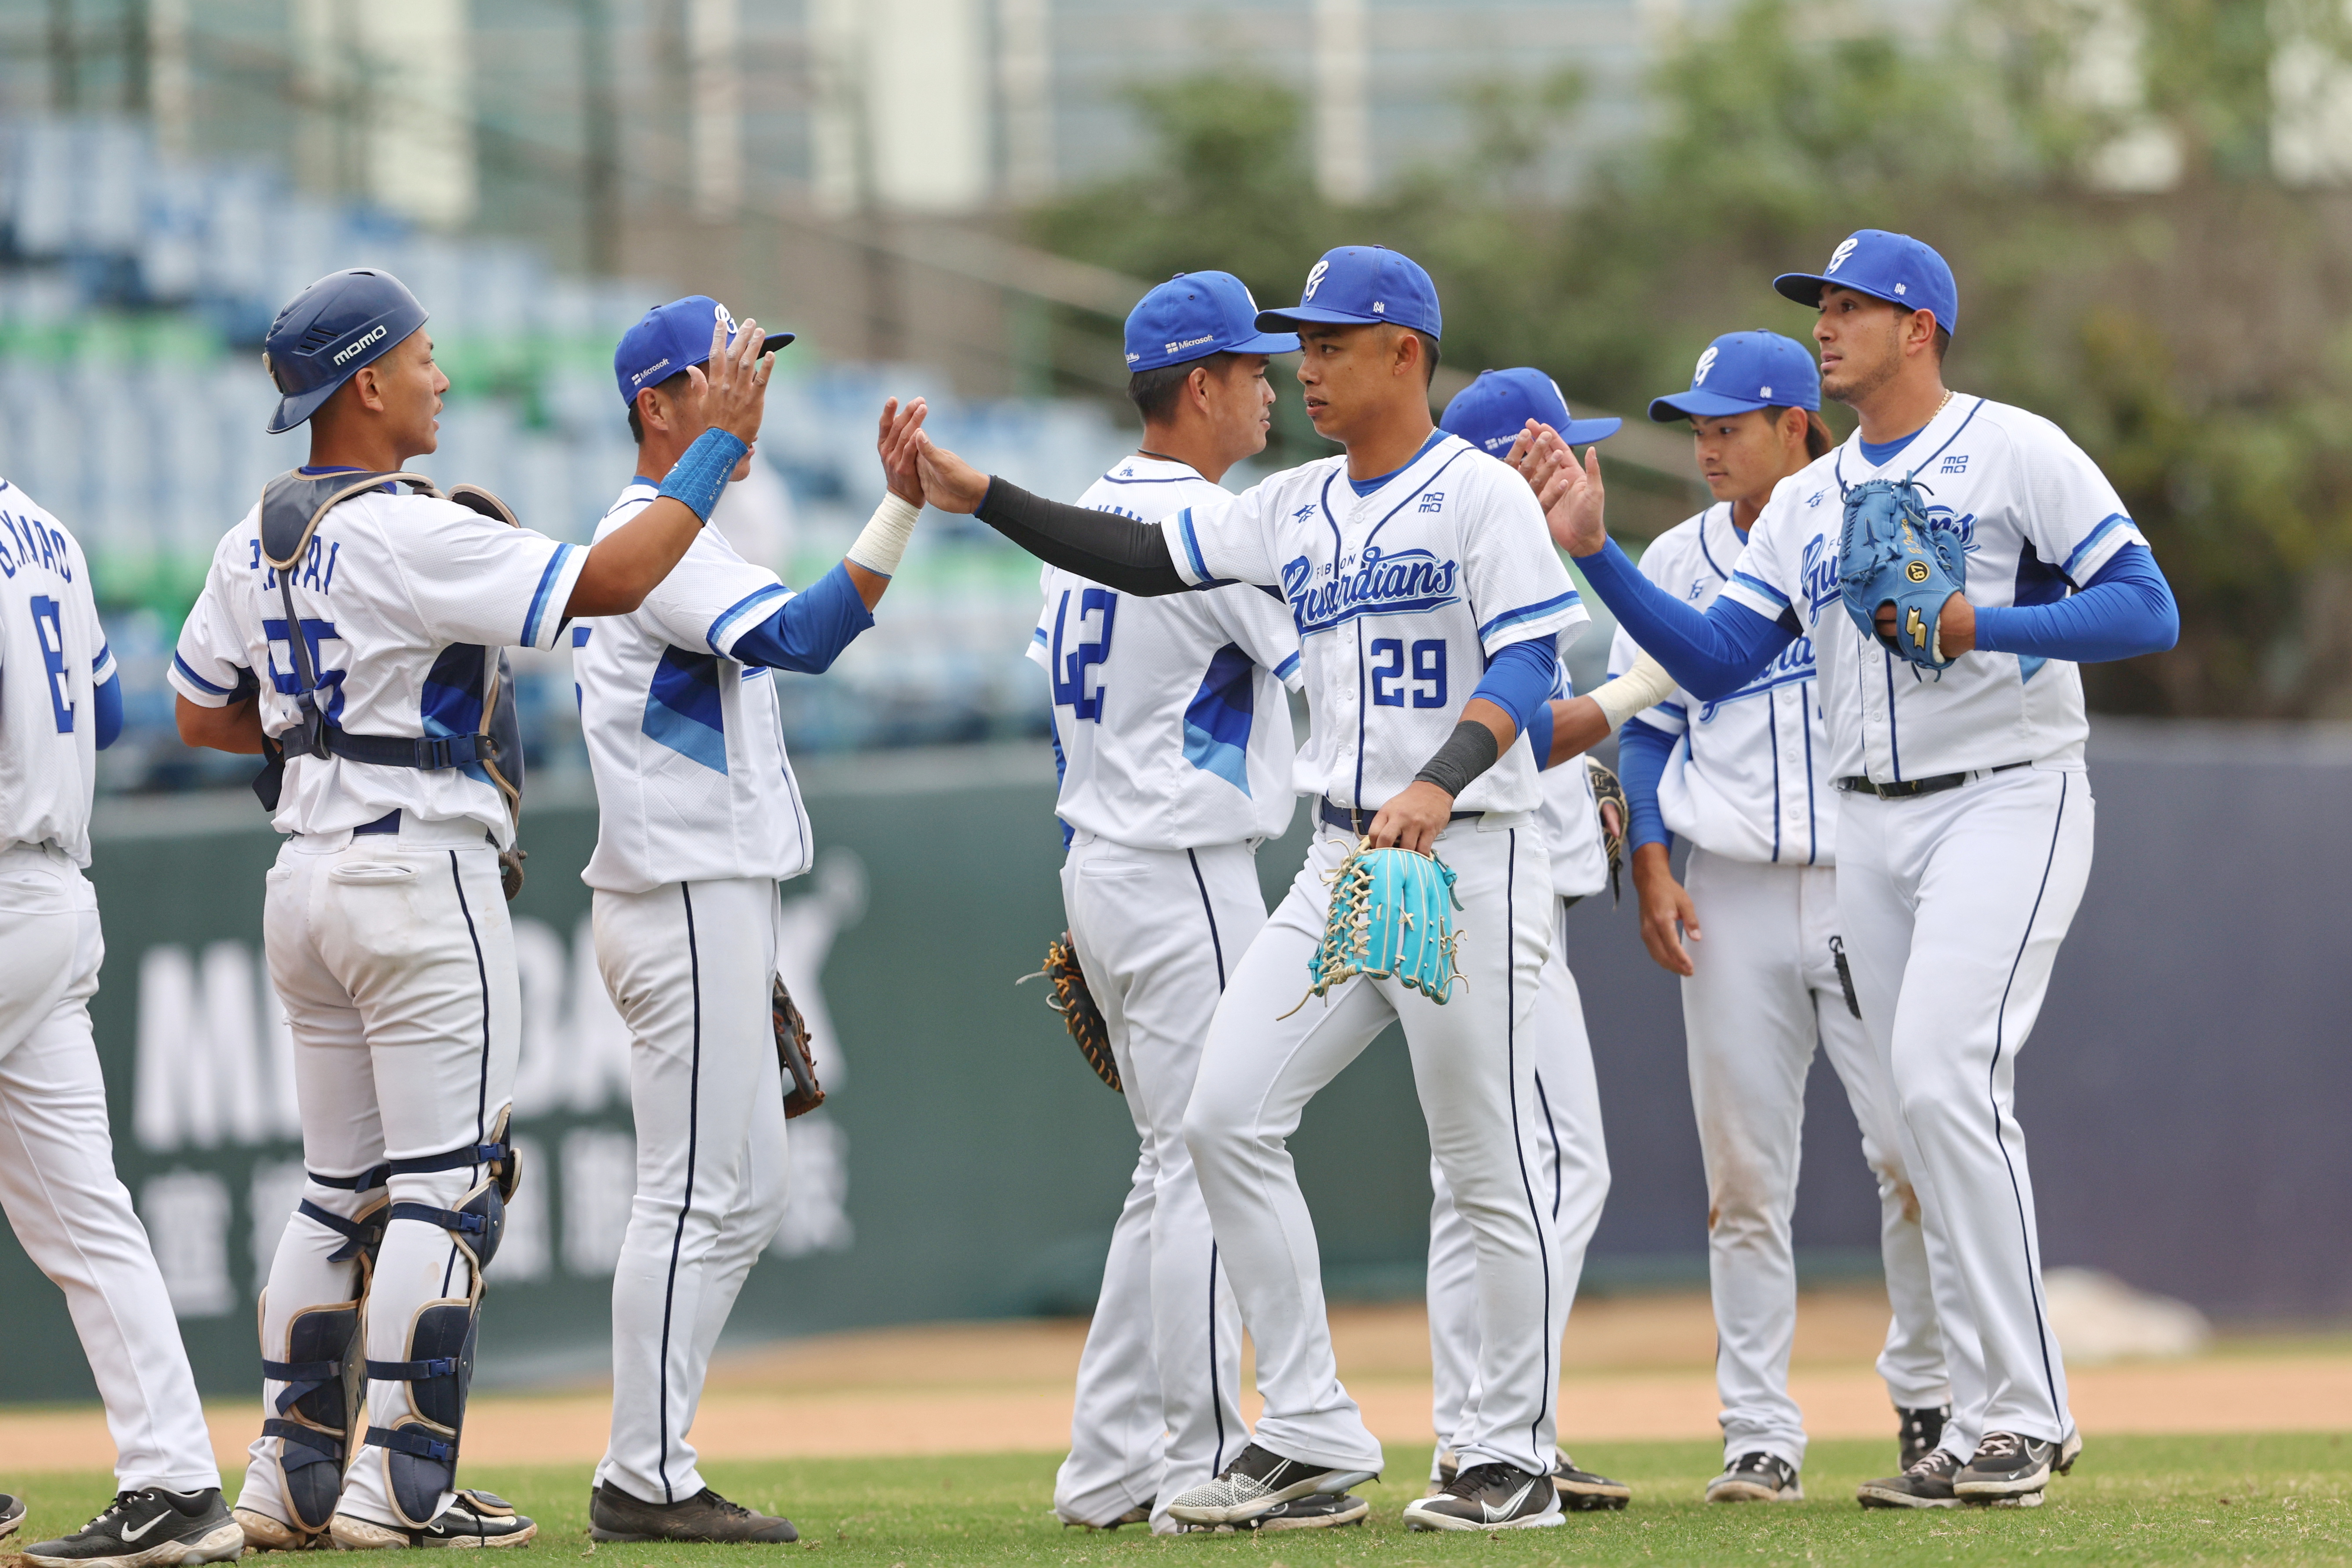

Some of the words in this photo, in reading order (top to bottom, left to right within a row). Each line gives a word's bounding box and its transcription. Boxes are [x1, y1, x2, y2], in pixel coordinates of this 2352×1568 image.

[1178, 334, 1213, 349] Microsoft
[640, 358, 669, 379] Microsoft
[1497, 433, 1520, 445] Micro
[1910, 565, 1926, 580] 87
[1281, 546, 1461, 643] Guardians
[1053, 588, 1118, 724] 42
[1371, 638, 1447, 709] 29
